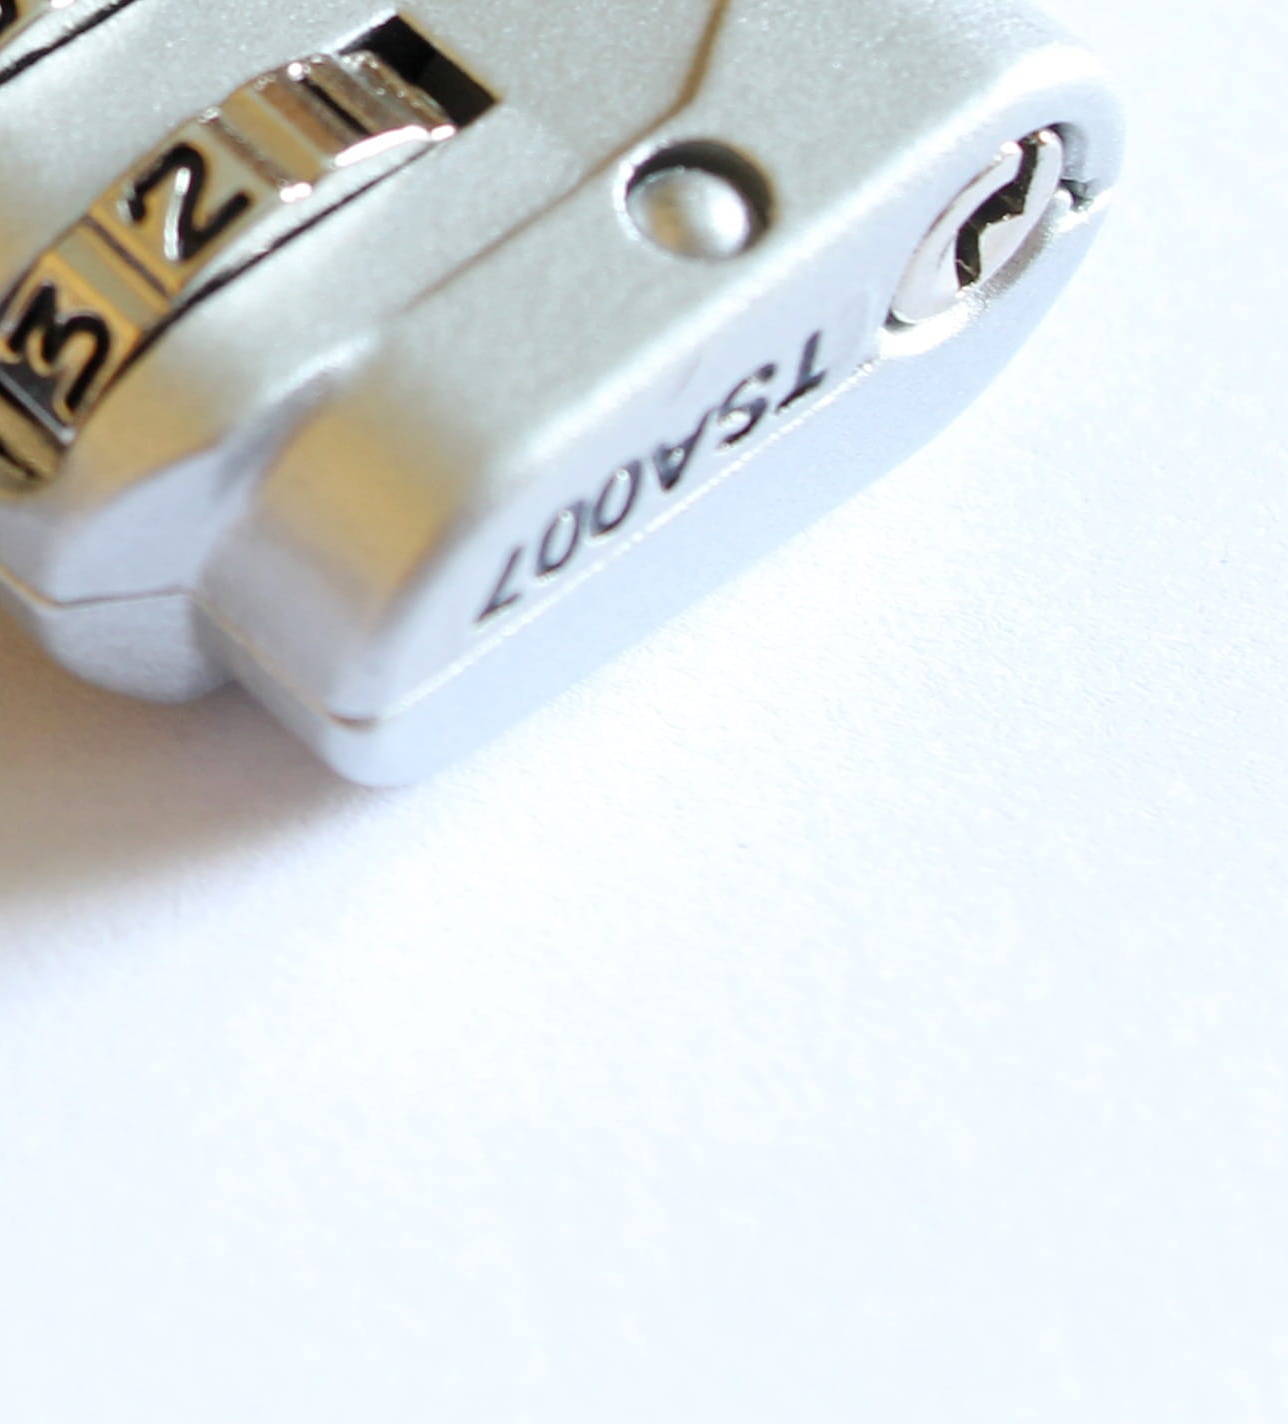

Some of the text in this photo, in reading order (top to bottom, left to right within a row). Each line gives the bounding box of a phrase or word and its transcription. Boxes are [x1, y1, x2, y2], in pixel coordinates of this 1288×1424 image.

[2, 278, 112, 413] 3
[118, 141, 254, 262] 2
[473, 328, 828, 624] TSA007
